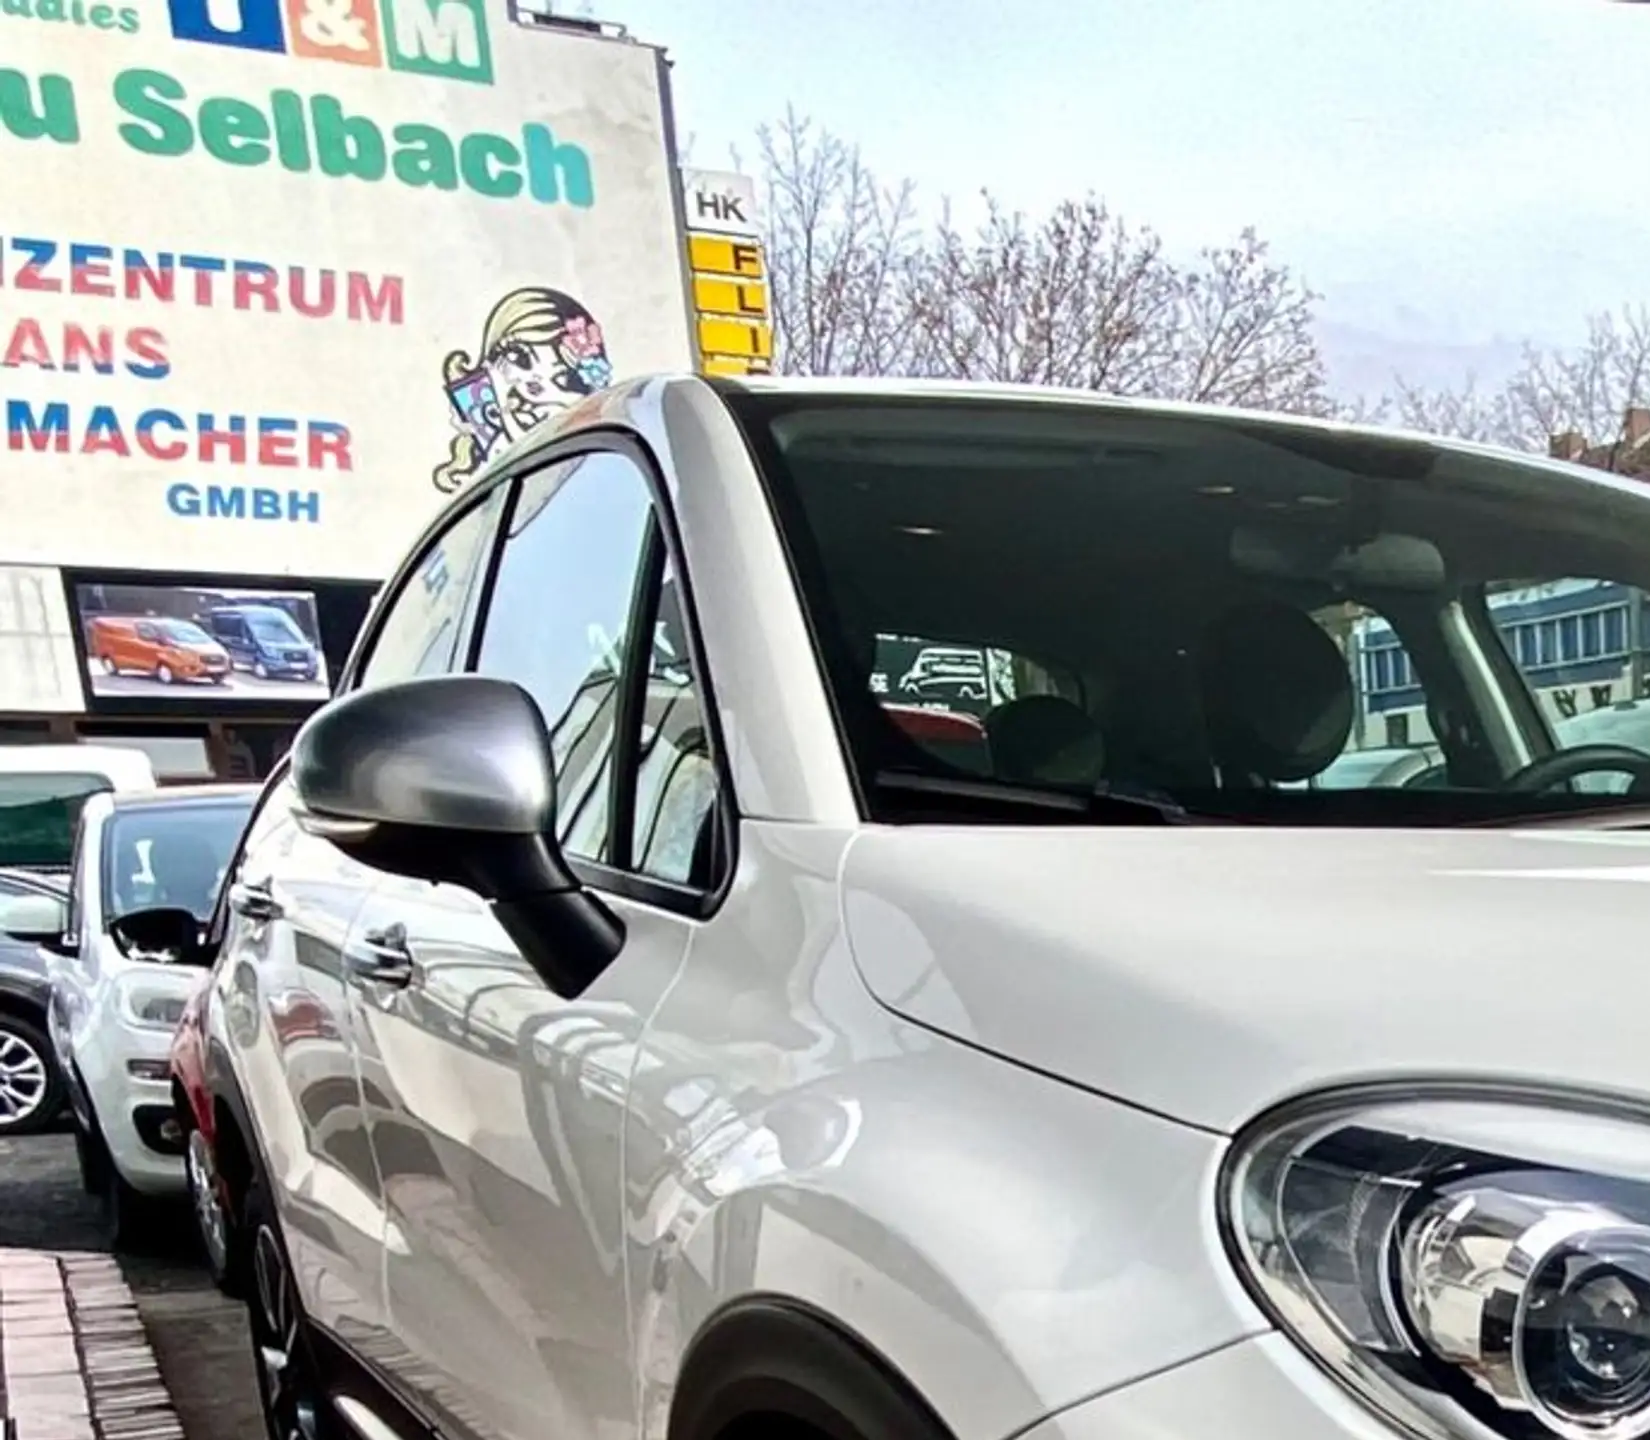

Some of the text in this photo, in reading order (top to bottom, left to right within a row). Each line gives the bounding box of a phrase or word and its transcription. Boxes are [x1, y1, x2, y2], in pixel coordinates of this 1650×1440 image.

[112, 68, 595, 208] Selbach
[696, 191, 747, 223] HK
[0, 235, 405, 325] ZENTRUM
[6, 400, 354, 471] MACHER
[166, 483, 320, 523] GMBH
